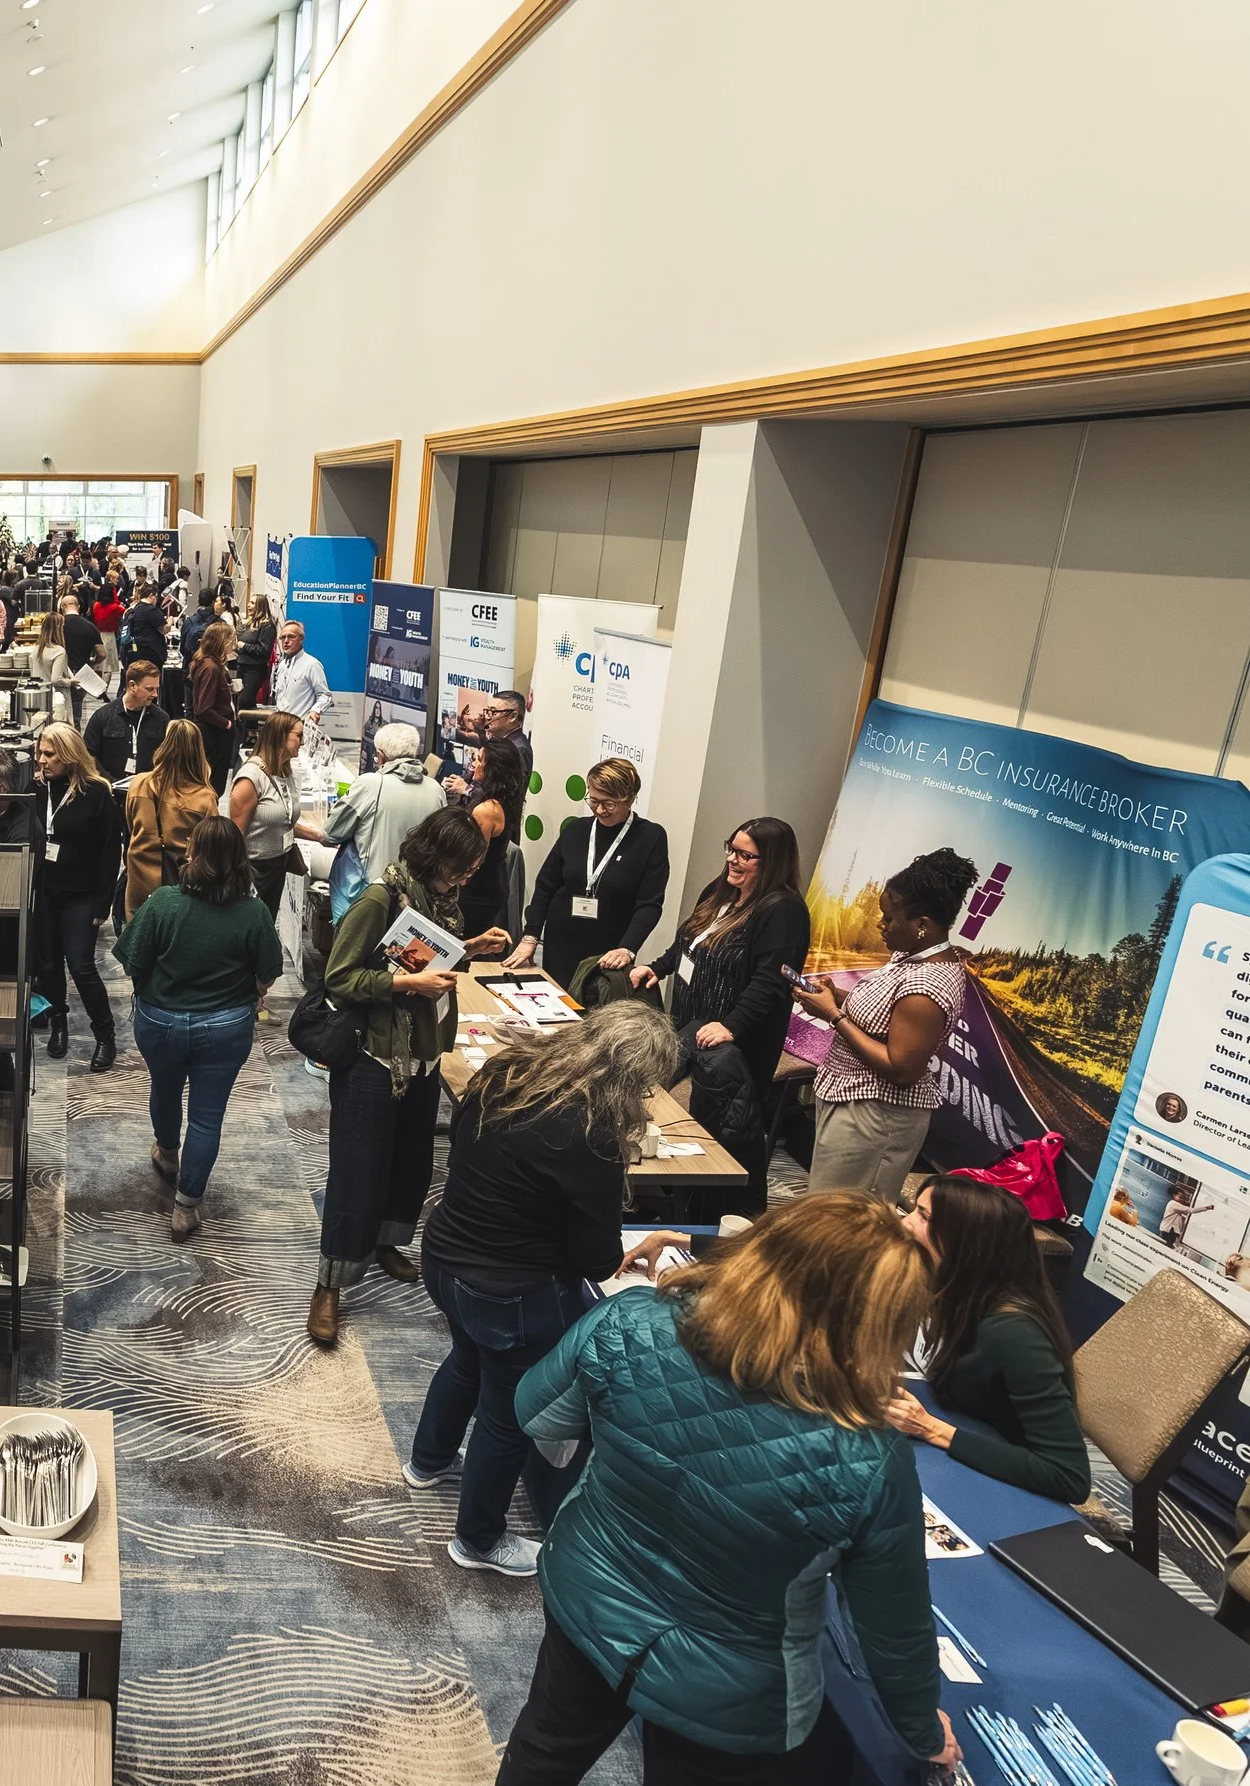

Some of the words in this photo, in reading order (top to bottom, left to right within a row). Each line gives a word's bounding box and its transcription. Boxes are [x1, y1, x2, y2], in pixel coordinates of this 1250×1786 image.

[293, 581, 367, 590] EducationPlannerBC
[296, 592, 314, 600] Find
[317, 593, 337, 601] Your
[338, 593, 349, 601] Fit
[406, 610, 421, 621] CFEE
[471, 604, 498, 621] CFEE
[470, 635, 480, 648] IG
[369, 662, 393, 682] MONEY
[400, 668, 424, 689] YOUTH
[447, 672, 470, 688] MONEY
[477, 678, 499, 695] YOUTH
[601, 734, 645, 763] Financial
[864, 723, 930, 762] BECOME
[932, 747, 948, 767] A
[957, 746, 995, 776] BC
[996, 760, 1100, 809] INSURANCE
[1098, 790, 1188, 835] BROKER
[881, 764, 892, 777] You
[892, 769, 911, 782] Learn
[922, 776, 956, 794] Flexible
[955, 785, 993, 802] Schedule
[1002, 798, 1039, 819] Mentoring
[1046, 811, 1063, 825] Great
[1062, 817, 1086, 834] Potential
[1091, 828, 1109, 843] Work
[1108, 834, 1150, 856] Anywhere
[1151, 847, 1161, 859] In
[1162, 850, 1180, 864] BC
[407, 926, 428, 944] MONEY
[430, 941, 450, 959] YOUTH
[1236, 972, 1250, 986] di
[1220, 1027, 1243, 1042] can
[1215, 1044, 1246, 1062] their
[1203, 1081, 1250, 1106] parents
[1195, 1110, 1228, 1129] Carmen
[1193, 1119, 1226, 1138] Director
[1226, 1135, 1237, 1143] of
[1104, 1220, 1125, 1236] Leading
[1135, 1238, 1149, 1248] class
[1149, 1246, 1182, 1267] experiment
[1181, 1263, 1190, 1271] on
[1190, 1268, 1207, 1281] Clean
[1207, 1277, 1229, 1293] Energy
